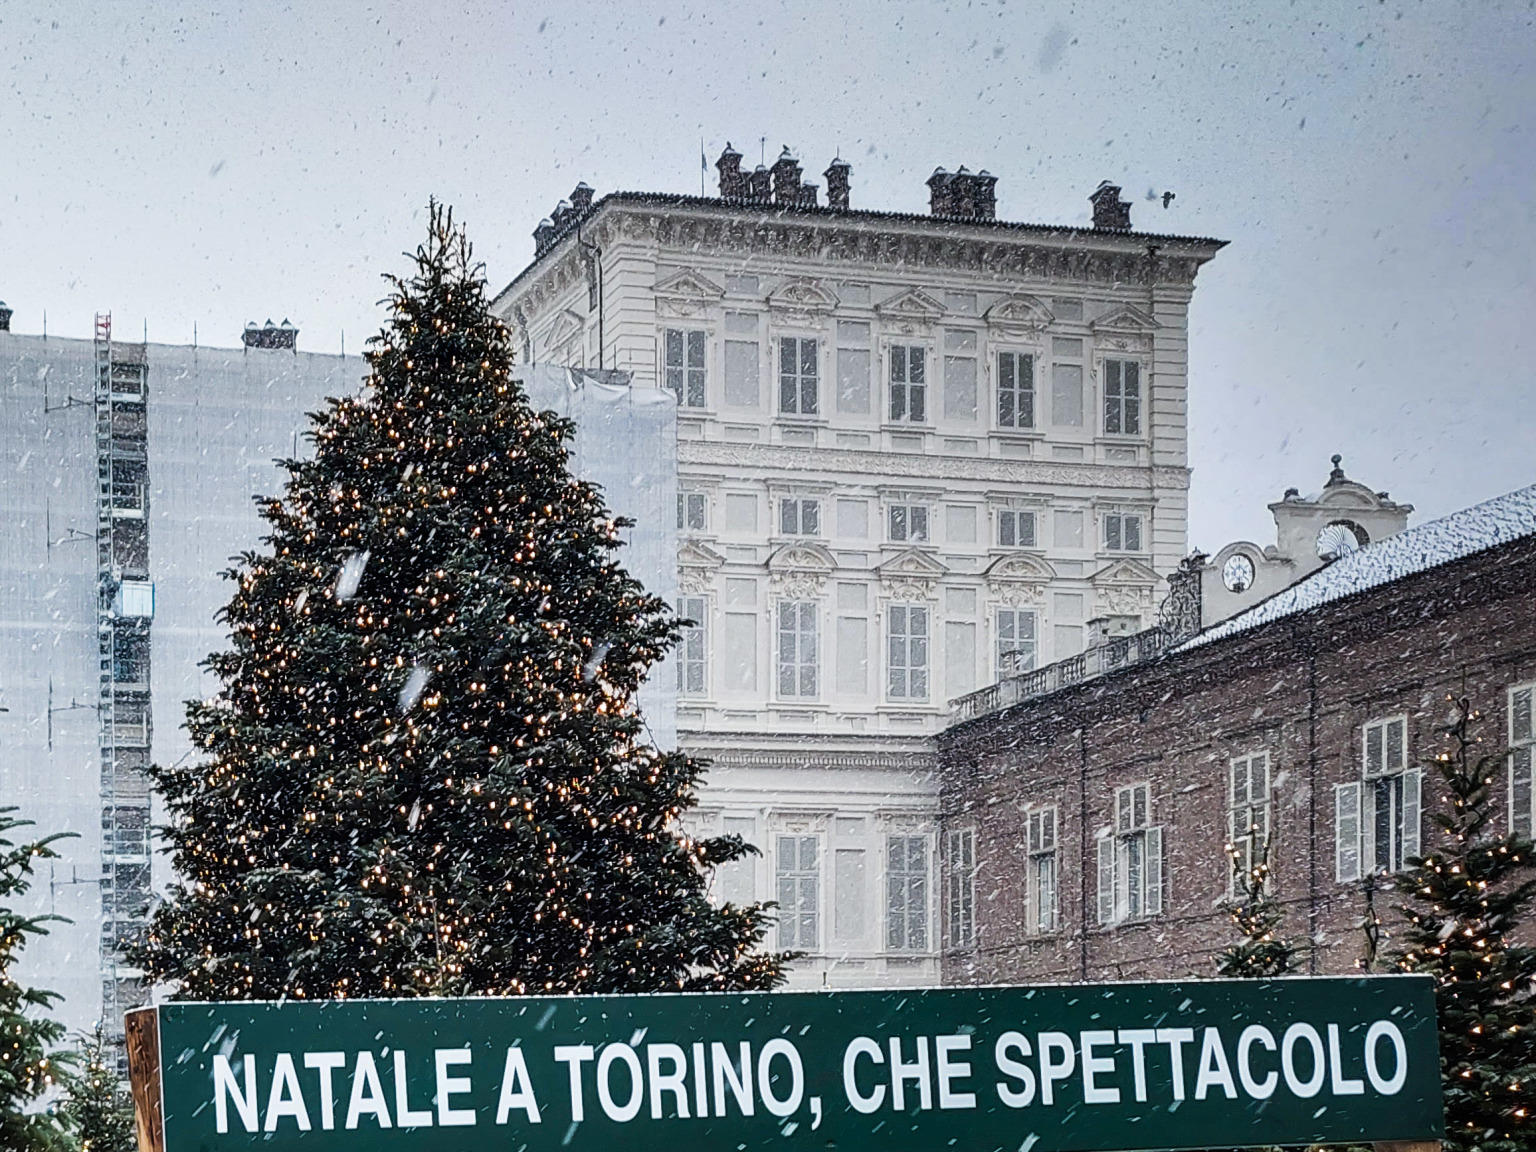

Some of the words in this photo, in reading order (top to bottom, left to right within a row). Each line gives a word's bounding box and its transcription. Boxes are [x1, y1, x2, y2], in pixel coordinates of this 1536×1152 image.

[213, 1050, 476, 1133] NATALE
[496, 1047, 541, 1124] A
[554, 1038, 822, 1130] TORINO,
[843, 1034, 976, 1114] CHE
[995, 1020, 1407, 1108] SPETTACOLO
